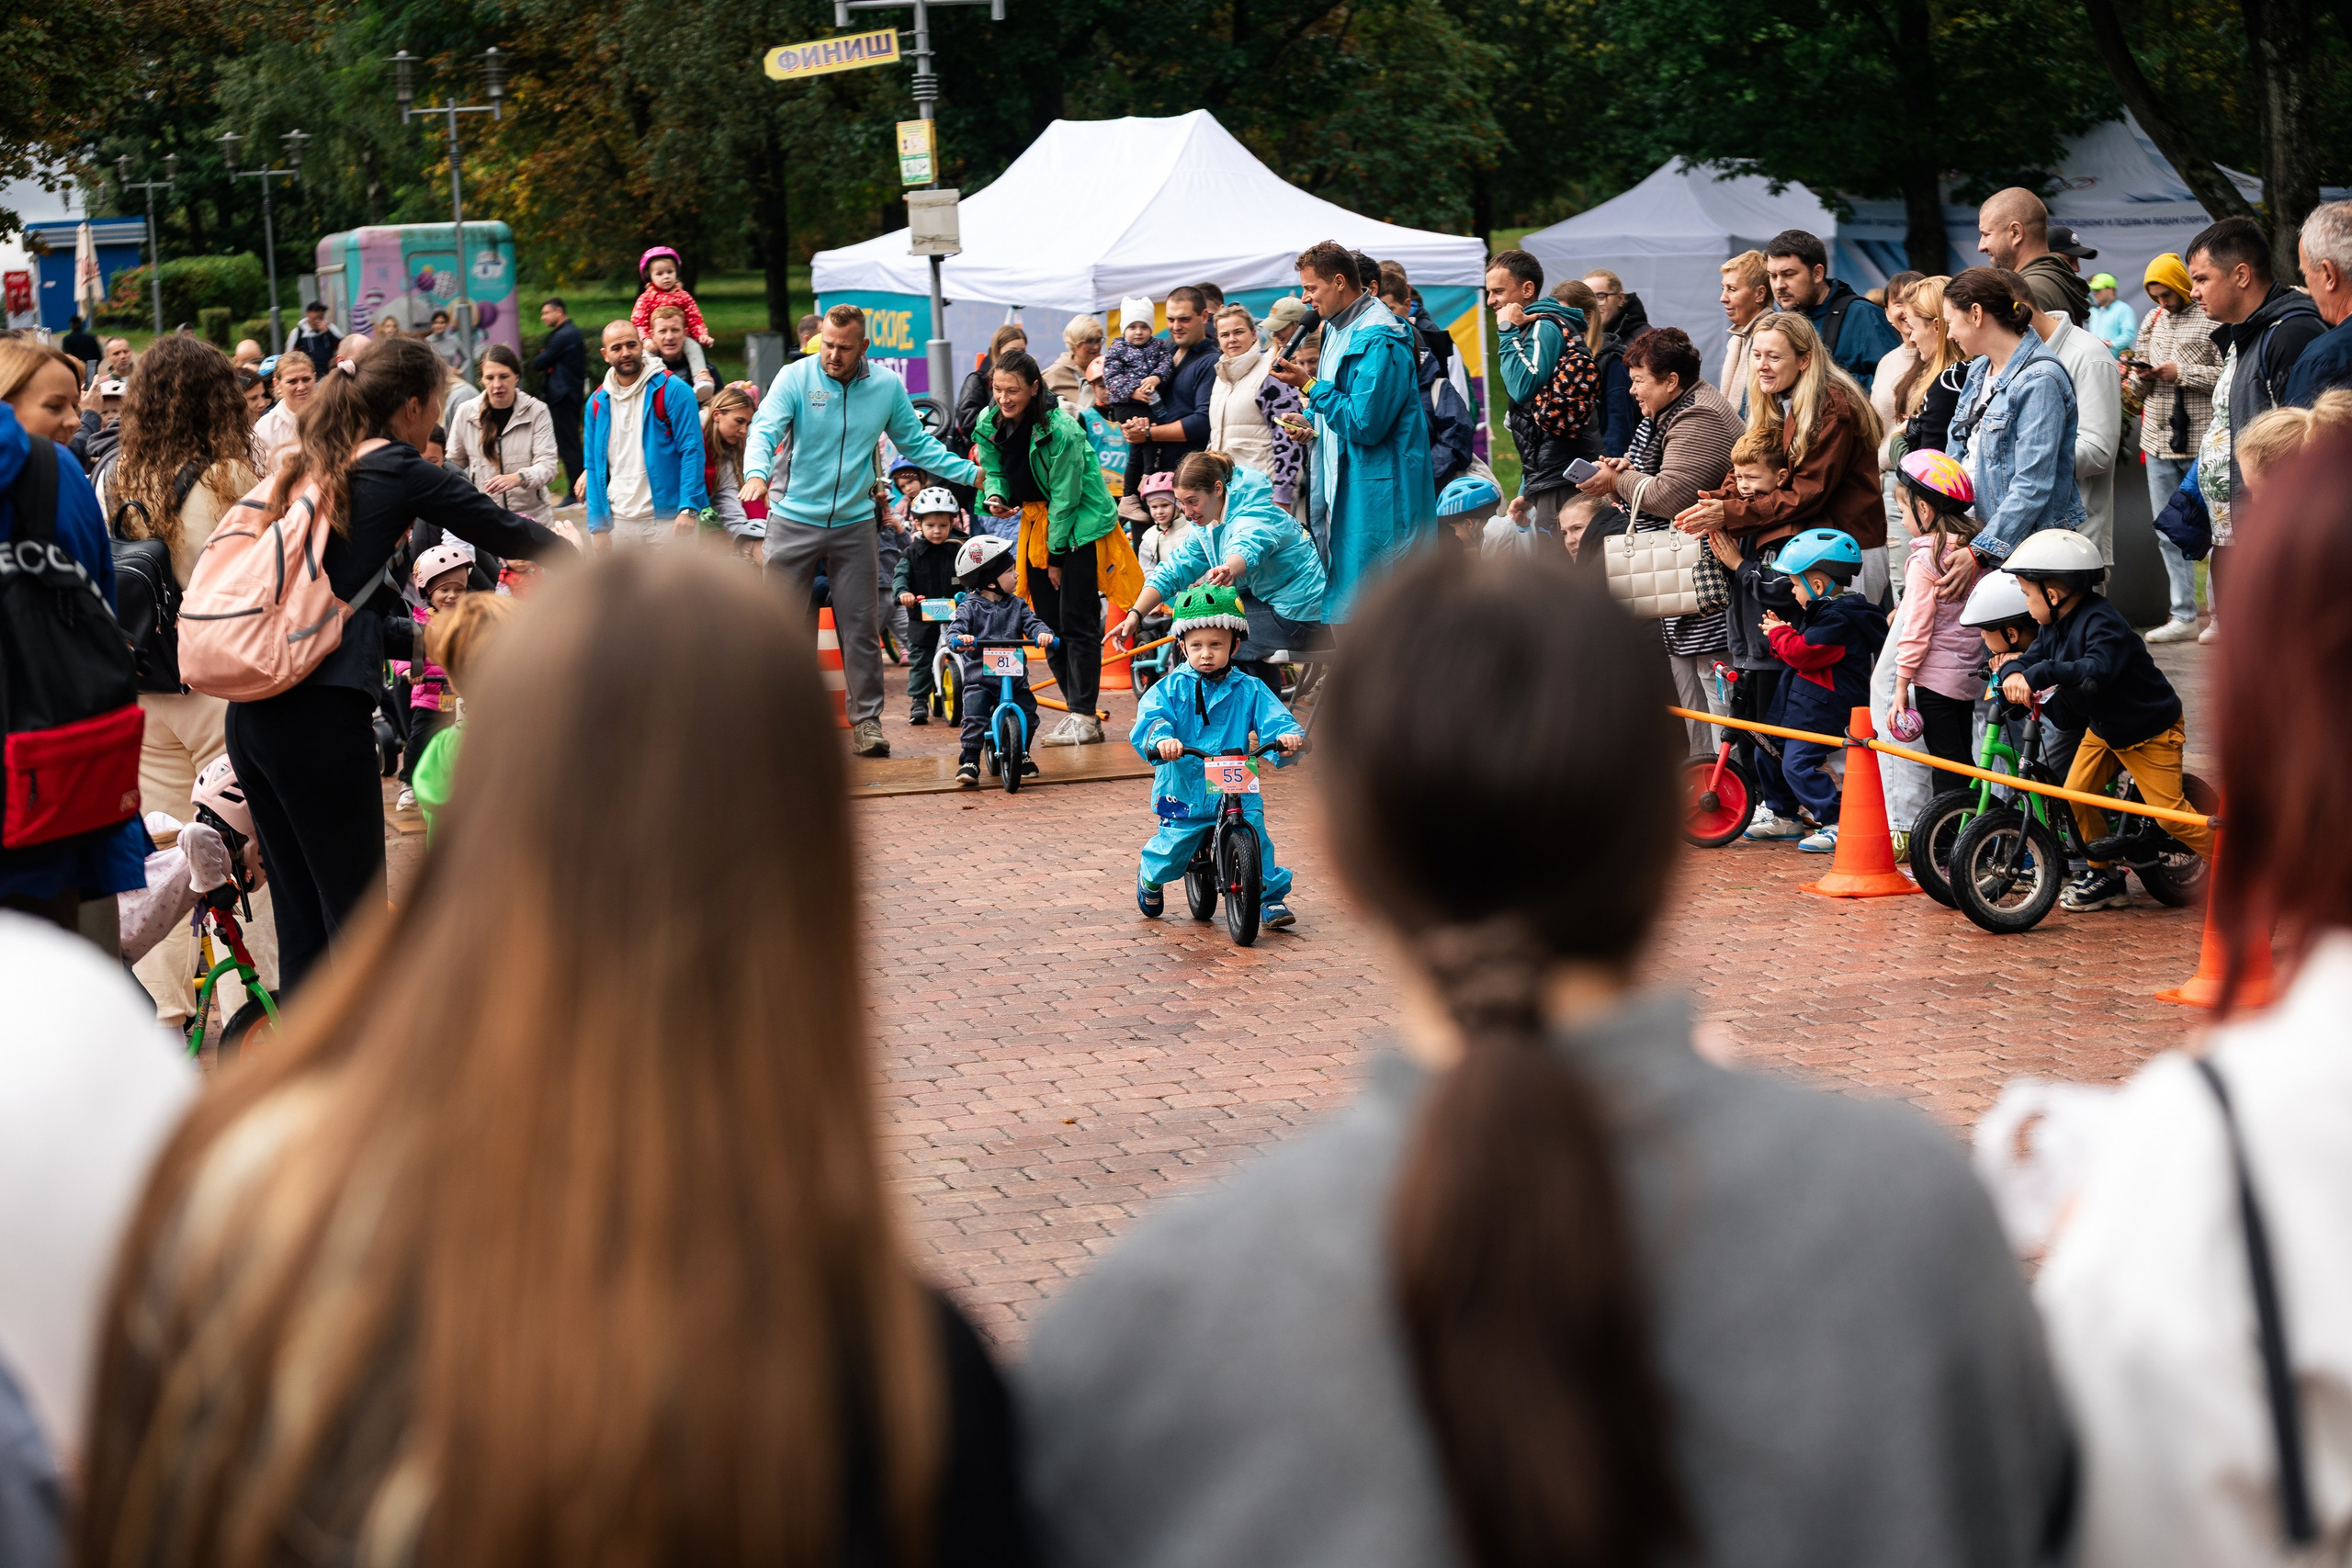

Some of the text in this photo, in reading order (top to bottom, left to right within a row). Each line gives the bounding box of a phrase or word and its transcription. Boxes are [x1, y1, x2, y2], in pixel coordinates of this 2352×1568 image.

[777, 33, 894, 72] ФИНИШ
[863, 308, 914, 350] ТСКИЕ
[1099, 450, 1126, 468] 977
[930, 606, 949, 615] 170
[997, 656, 1010, 668] 81
[1223, 768, 1243, 783] 55
